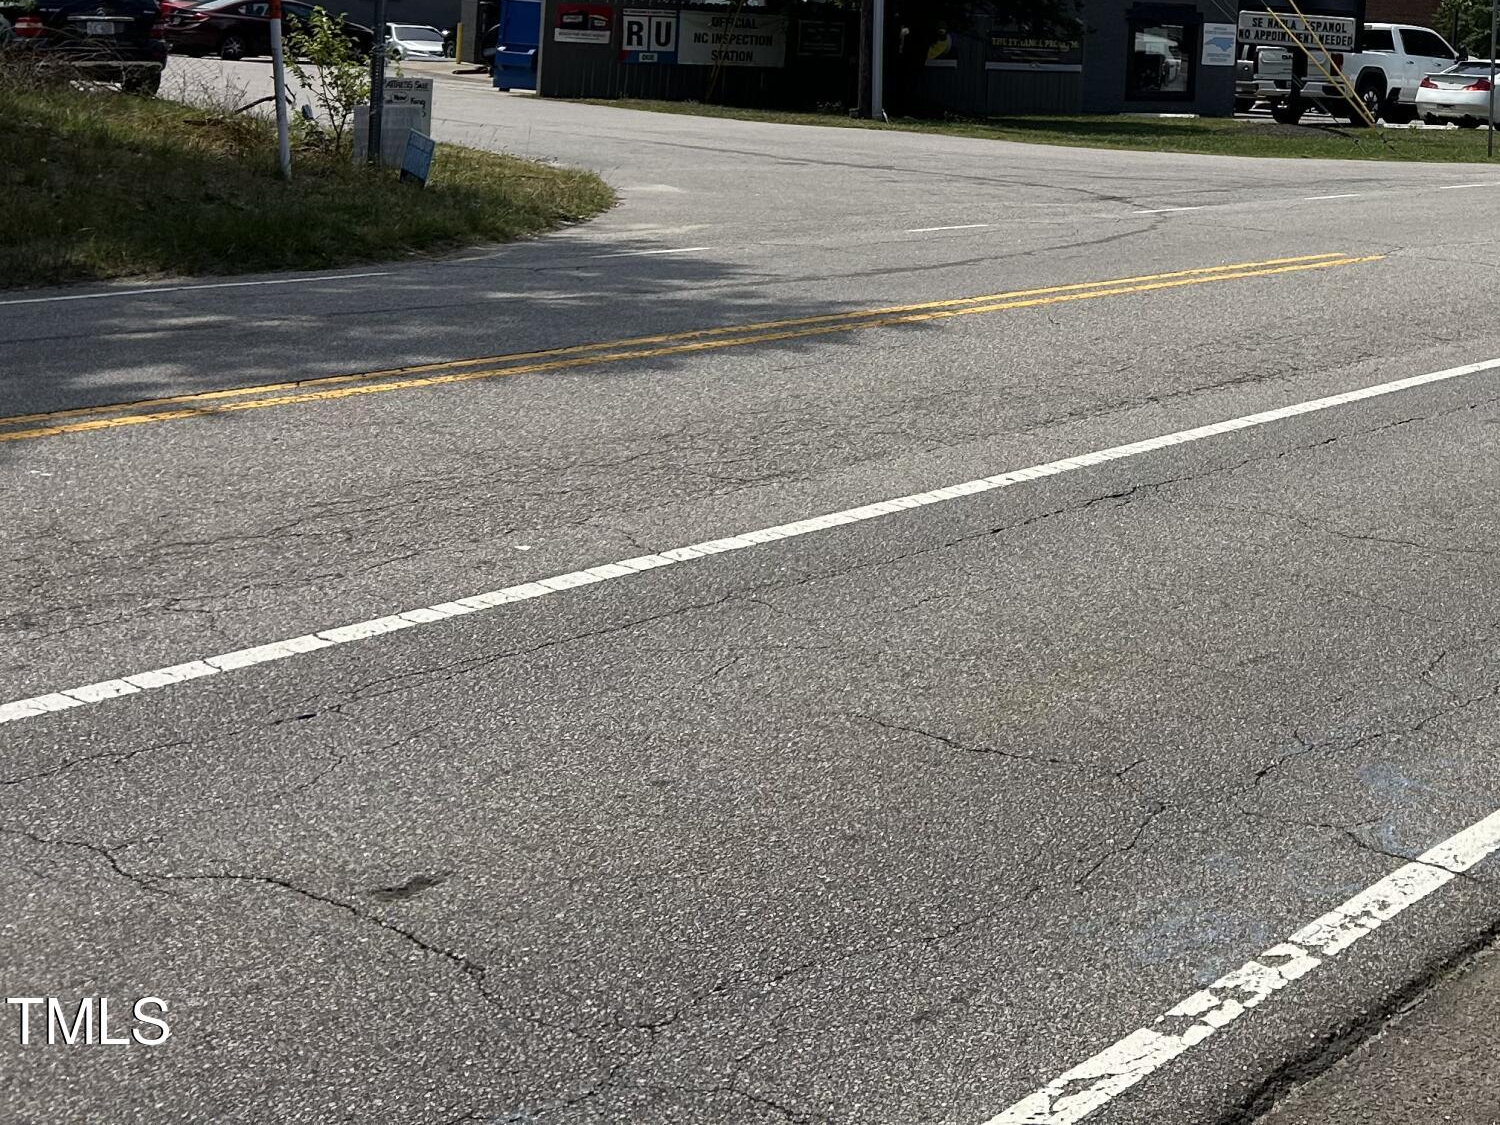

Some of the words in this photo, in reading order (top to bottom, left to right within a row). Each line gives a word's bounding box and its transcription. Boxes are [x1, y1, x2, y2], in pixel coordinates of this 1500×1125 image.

[1252, 17, 1263, 28] SE
[694, 32, 709, 43] NC
[711, 33, 773, 46] INSPECTION
[1238, 28, 1251, 39] NO
[711, 49, 753, 62] STATION
